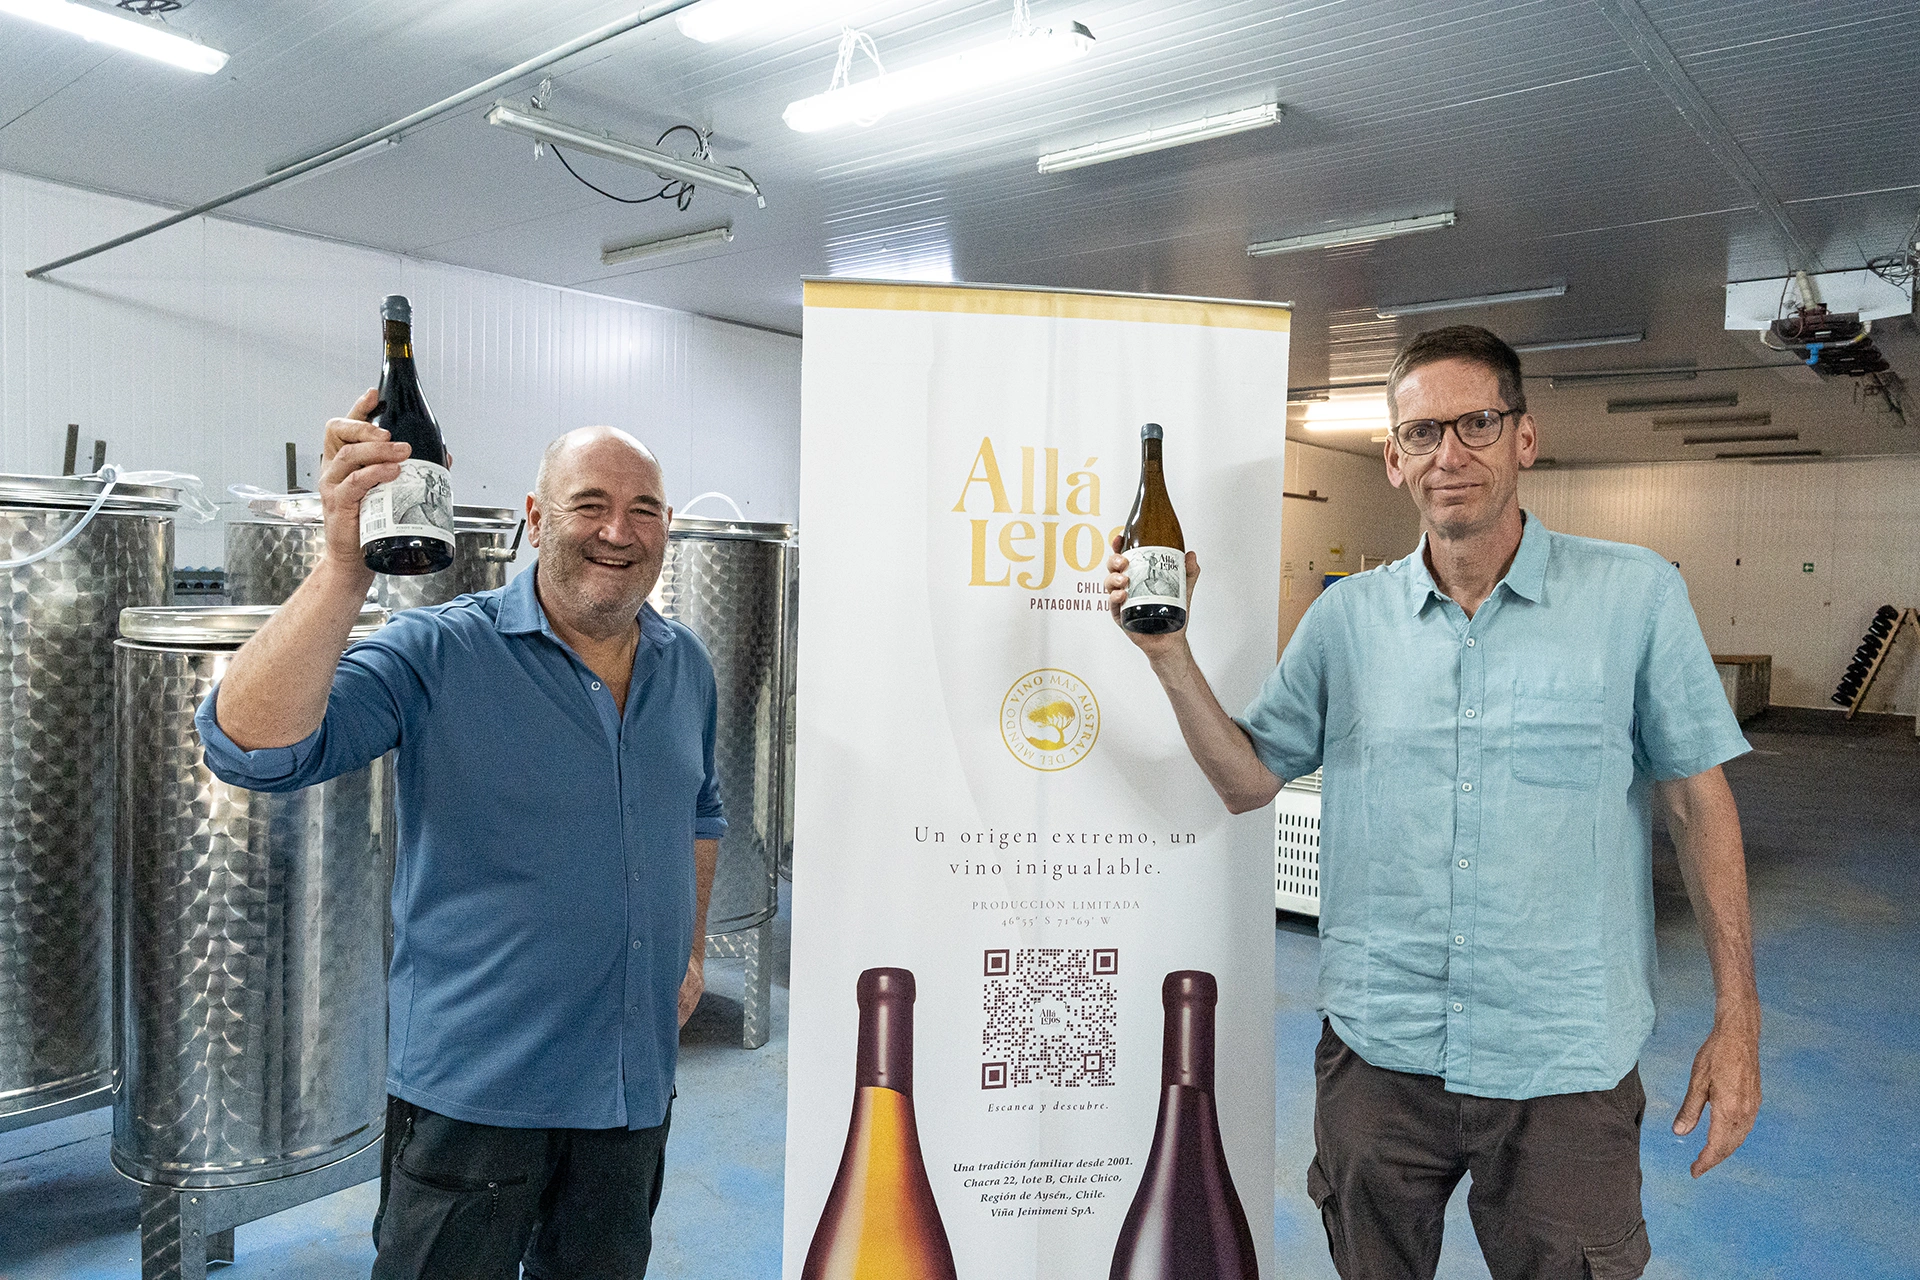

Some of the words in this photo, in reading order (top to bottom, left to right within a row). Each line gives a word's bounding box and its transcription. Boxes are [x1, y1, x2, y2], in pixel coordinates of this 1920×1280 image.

[951, 436, 1101, 517] Allá
[1030, 598, 1092, 611] PATAGONIA
[1009, 675, 1044, 704] VINO
[1049, 675, 1079, 693] MAS
[1069, 694, 1095, 756] AUSTRAL
[1005, 707, 1035, 760] MUNDO
[1040, 753, 1066, 766] DEL
[914, 826, 946, 843] Un
[960, 828, 1038, 849] origen
[1052, 831, 1157, 846] extremo,
[1170, 831, 1197, 844] un
[950, 859, 1002, 875] vino
[1016, 857, 1161, 880] inigualable.
[1072, 900, 1140, 910] LIMITADA
[1044, 916, 1051, 925] S
[1100, 916, 1111, 925] W
[1039, 1008, 1056, 1018] Allá
[1041, 1017, 1061, 1025] Lejos
[988, 1103, 1034, 1112] Escanea
[1039, 1104, 1047, 1114] y
[1053, 1100, 1109, 1111] descubre.
[953, 1163, 975, 1172] Una
[978, 1160, 1026, 1171] tradición
[1028, 1158, 1074, 1171] familiar
[1076, 1158, 1105, 1168] desde
[1107, 1157, 1133, 1167] 2001.
[963, 1178, 1000, 1188] Chacra
[1003, 1176, 1018, 1186] 22,
[1021, 1175, 1043, 1184] lote
[1045, 1174, 1056, 1185] B,
[1059, 1174, 1088, 1184] Chile
[1090, 1174, 1122, 1183] Chico,
[980, 1192, 1017, 1205] Región
[1019, 1191, 1032, 1200] de
[1075, 1190, 1106, 1200] Chile.
[990, 1207, 1014, 1217] Viña
[1017, 1206, 1068, 1218] Jeinimeni
[1070, 1206, 1095, 1217] SpA.
